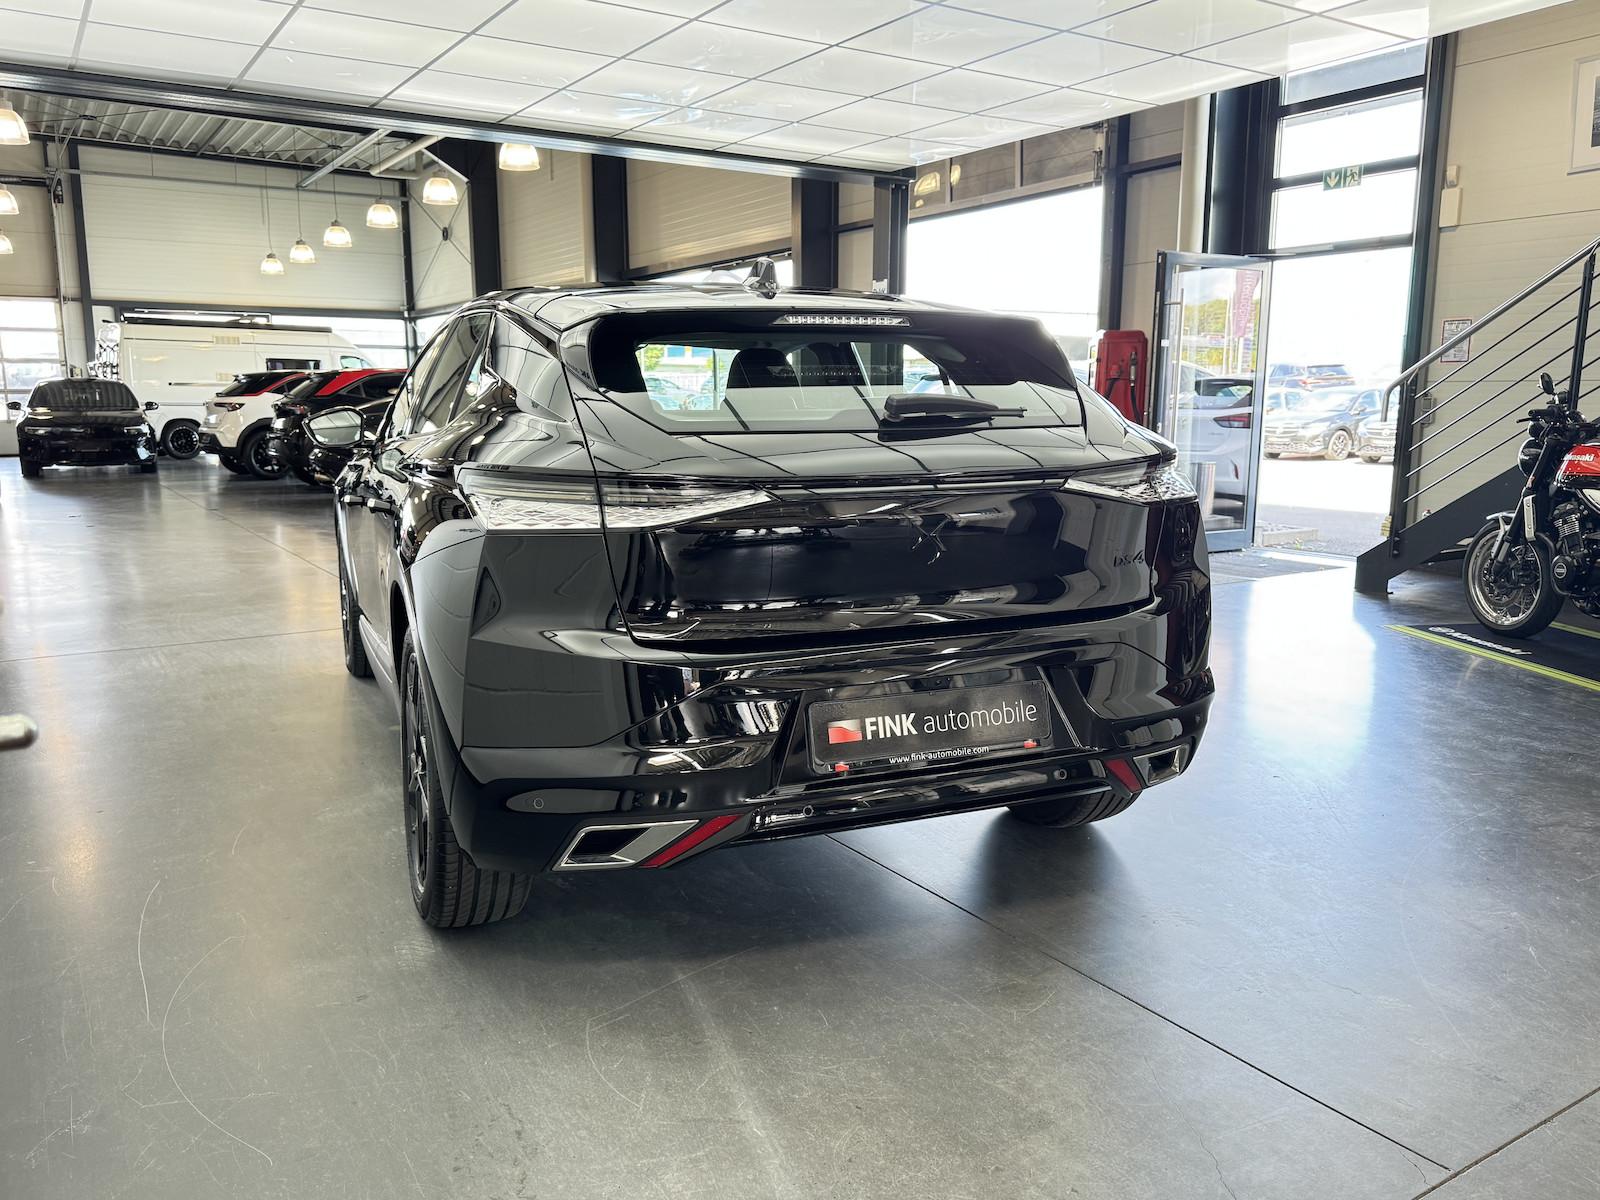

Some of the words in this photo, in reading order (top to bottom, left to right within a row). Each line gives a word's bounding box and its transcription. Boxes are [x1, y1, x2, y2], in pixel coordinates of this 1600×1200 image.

[864, 712, 918, 740] FINK
[923, 700, 1037, 734] automobile
[888, 745, 990, 764] www.fink-automobile.com
